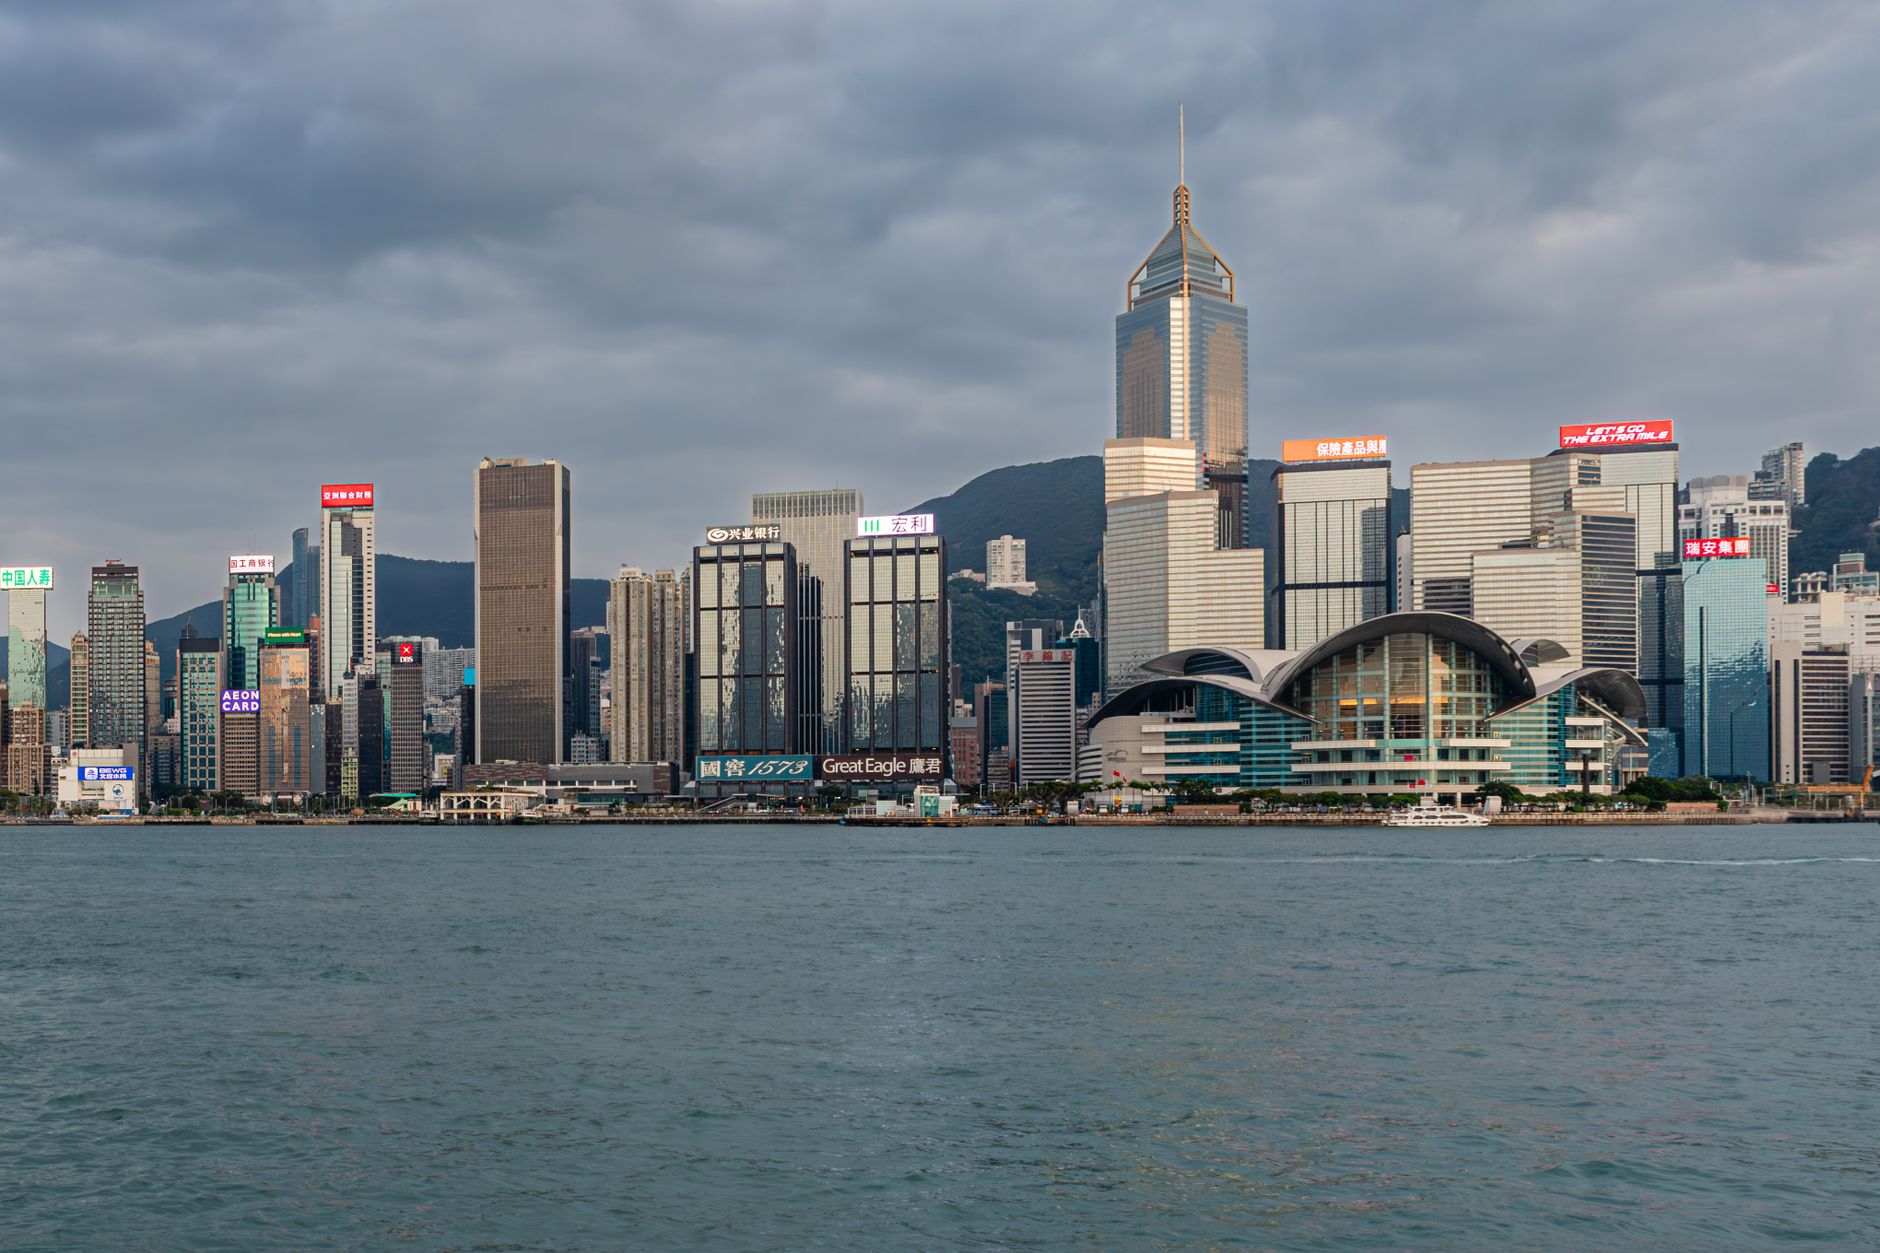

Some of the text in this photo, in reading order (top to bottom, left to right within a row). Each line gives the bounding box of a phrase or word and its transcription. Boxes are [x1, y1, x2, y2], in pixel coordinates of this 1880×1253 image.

[1563, 430, 1668, 445] THE EXTRA MILE
[1585, 424, 1645, 436] LET'S GO
[892, 516, 927, 532] 宏利
[728, 527, 779, 540] 兴业银行
[1686, 540, 1749, 555] 瑞安集團
[2, 569, 50, 587] 中国人寿
[222, 691, 259, 700] AEON
[222, 702, 259, 711] CARD
[822, 757, 942, 777] Great Eagle 鷹君
